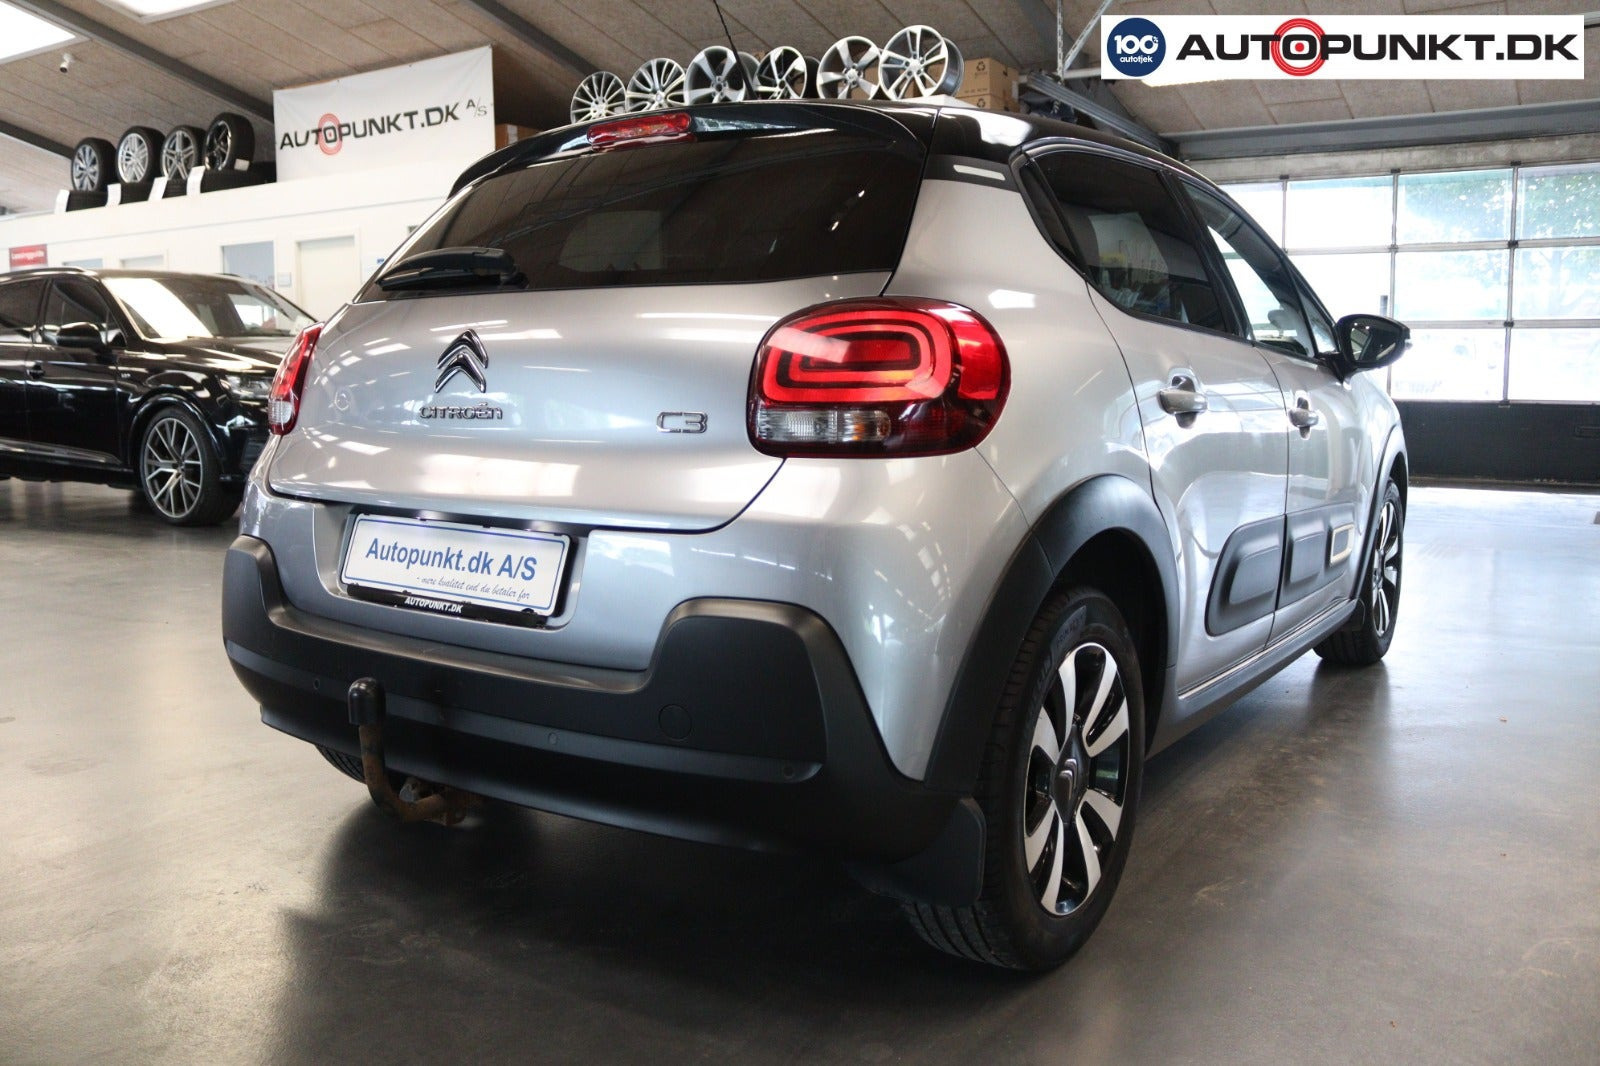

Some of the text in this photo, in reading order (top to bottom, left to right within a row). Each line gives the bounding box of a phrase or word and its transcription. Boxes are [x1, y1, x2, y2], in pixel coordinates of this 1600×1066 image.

[280, 98, 488, 150] AUTOPUNKT.DK A/S
[656, 411, 708, 434] C3
[366, 538, 538, 581] Autopunkt.dk A/S
[421, 577, 436, 586] mere
[438, 576, 465, 590] kvalitet
[466, 581, 479, 592] end
[480, 582, 491, 593] du
[492, 585, 516, 598] betaler
[516, 588, 531, 602] for
[404, 596, 463, 614] AUTOPUNKT.DK
